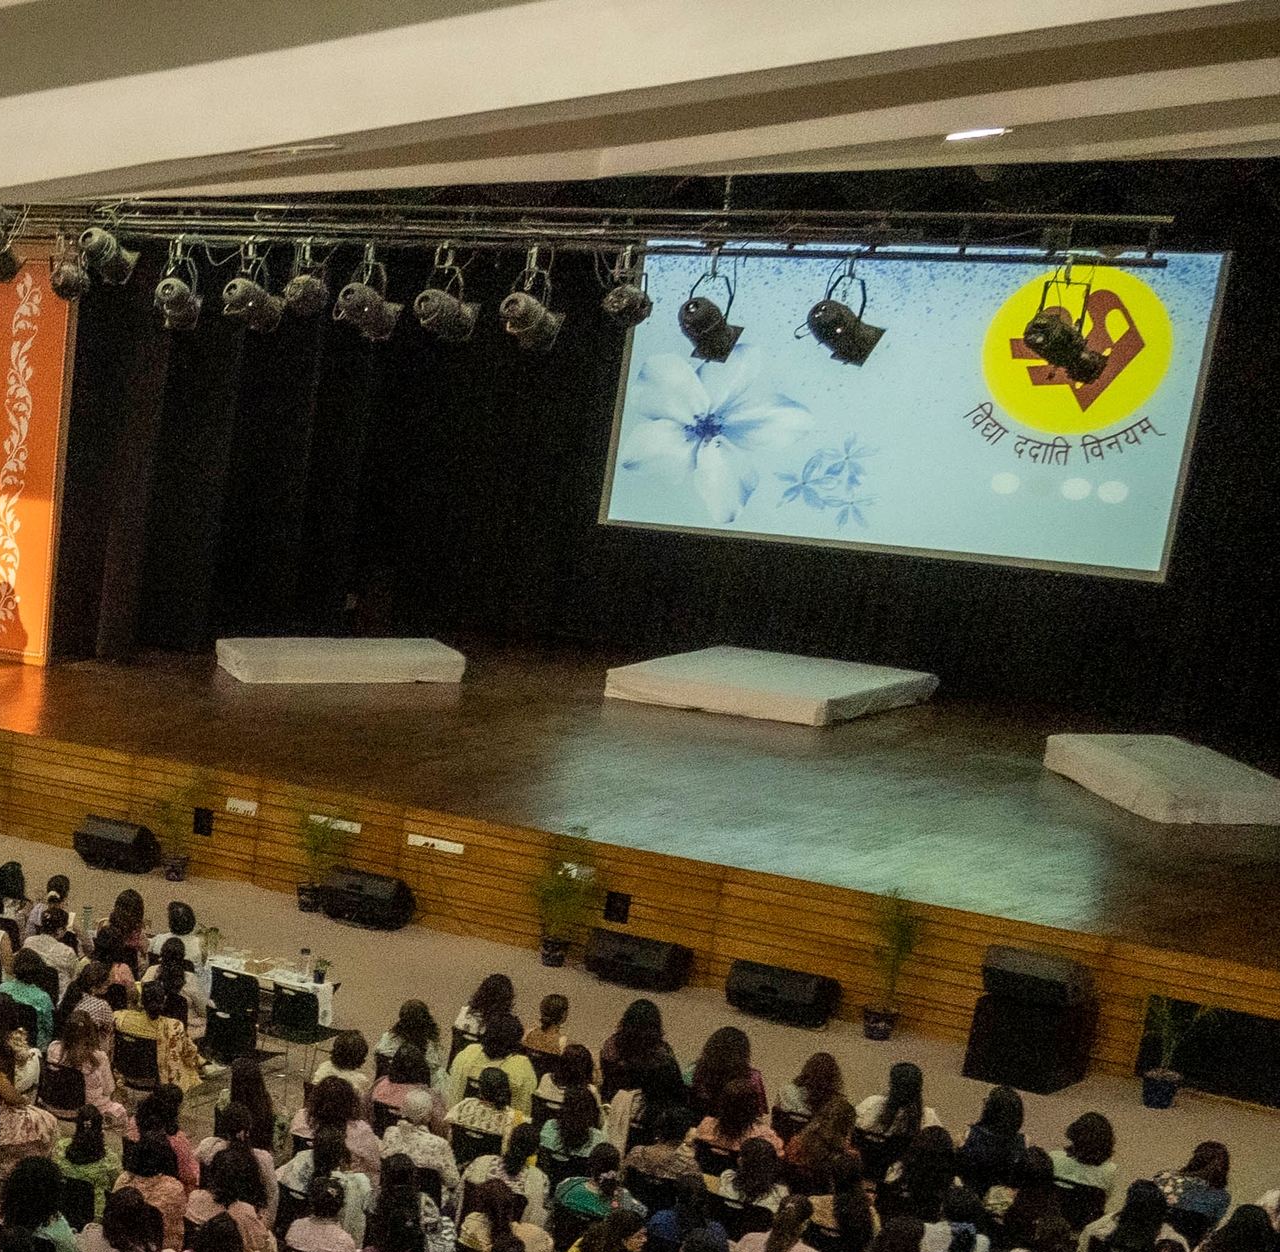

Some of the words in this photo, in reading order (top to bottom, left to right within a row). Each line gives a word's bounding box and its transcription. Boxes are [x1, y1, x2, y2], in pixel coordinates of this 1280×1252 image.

[963, 401, 1009, 446] विद्या
[1013, 435, 1072, 466] ददाति
[1080, 417, 1167, 464] विनयम्
